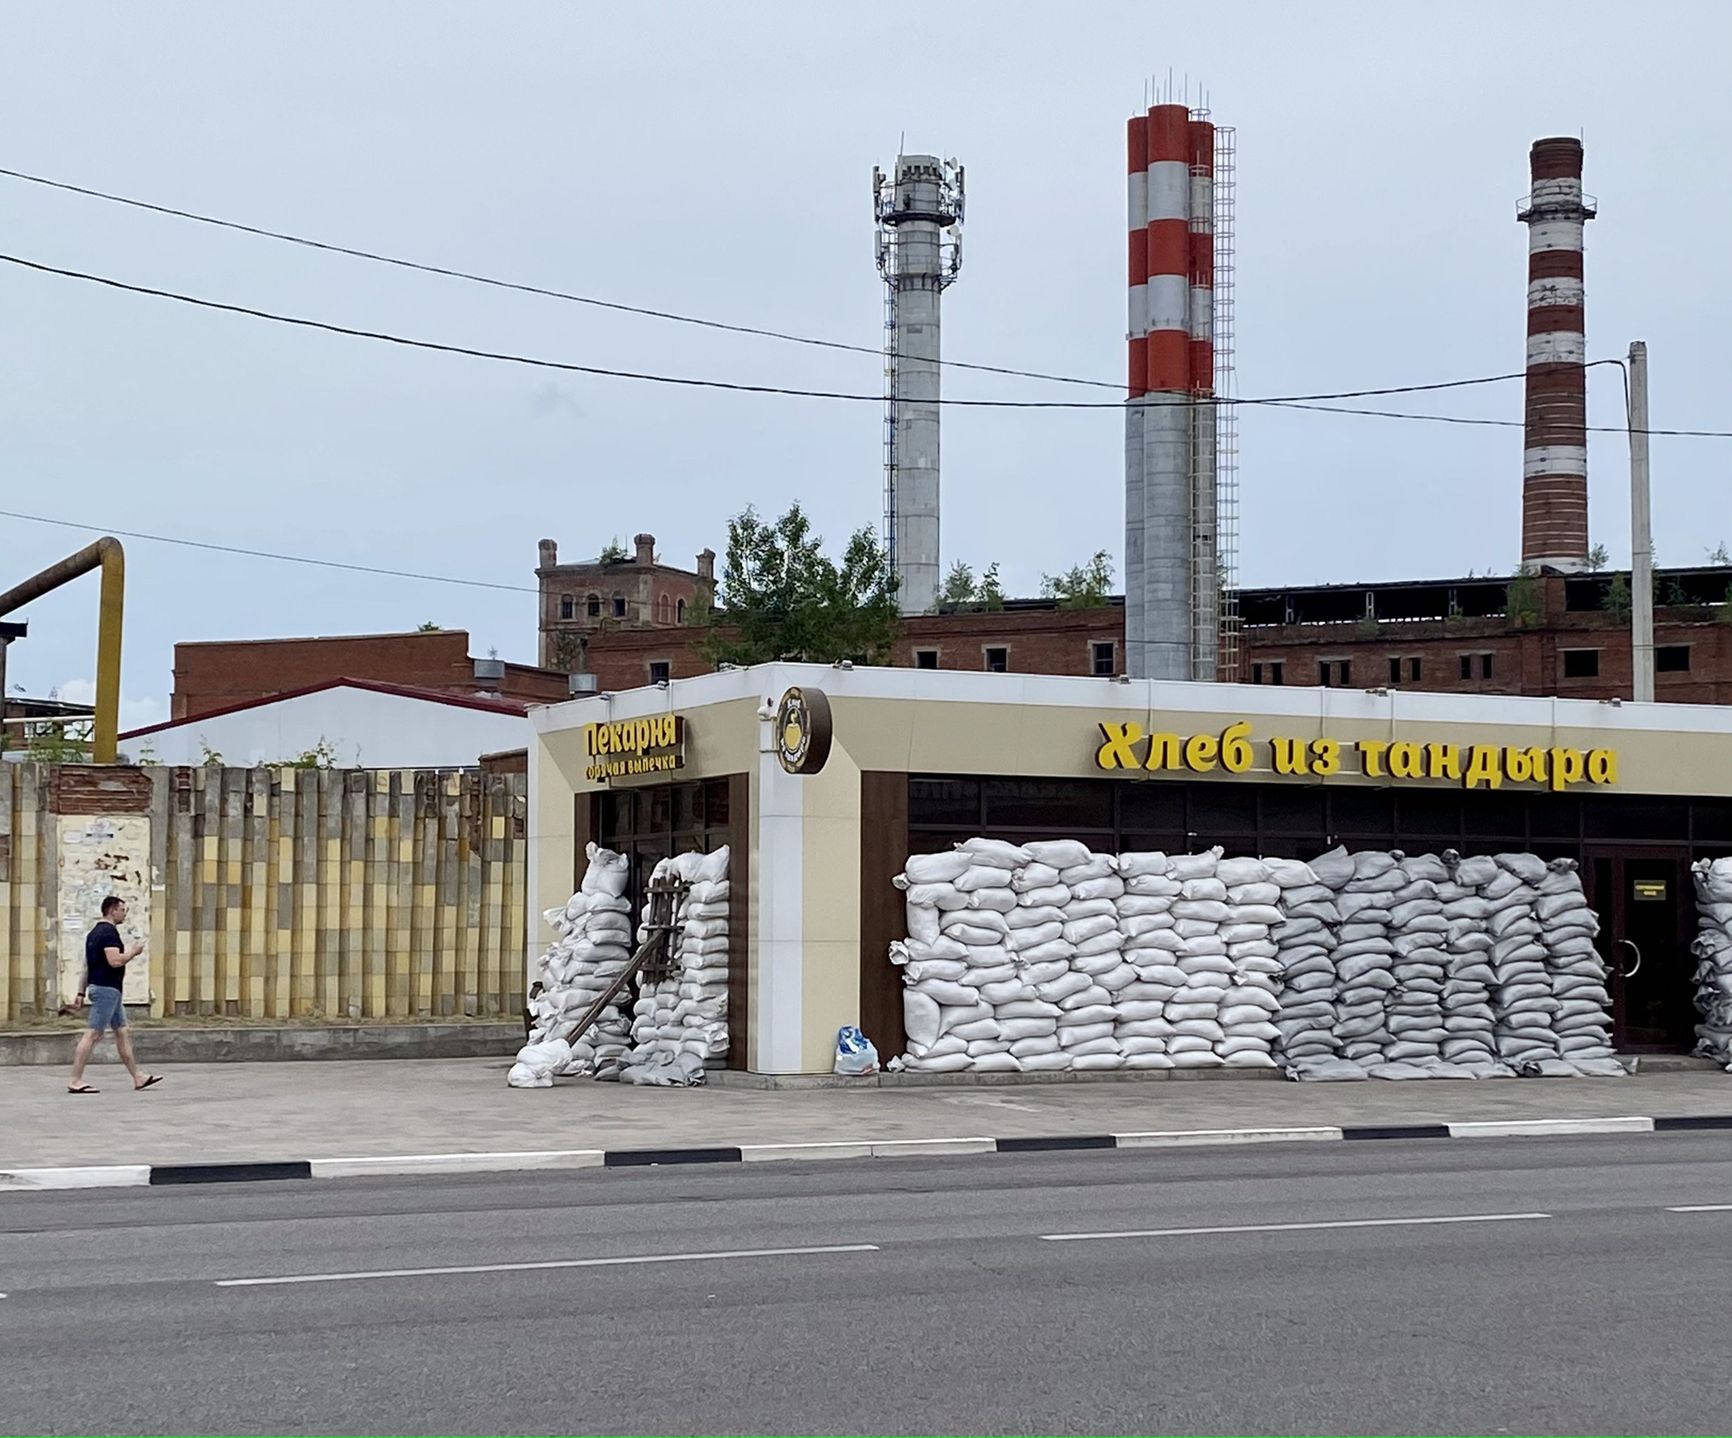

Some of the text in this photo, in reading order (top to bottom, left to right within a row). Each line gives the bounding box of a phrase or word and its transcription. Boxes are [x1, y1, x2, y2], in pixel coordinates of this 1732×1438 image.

[584, 714, 676, 756] Пекарня
[1096, 720, 1617, 791] Хлеб из тандыра
